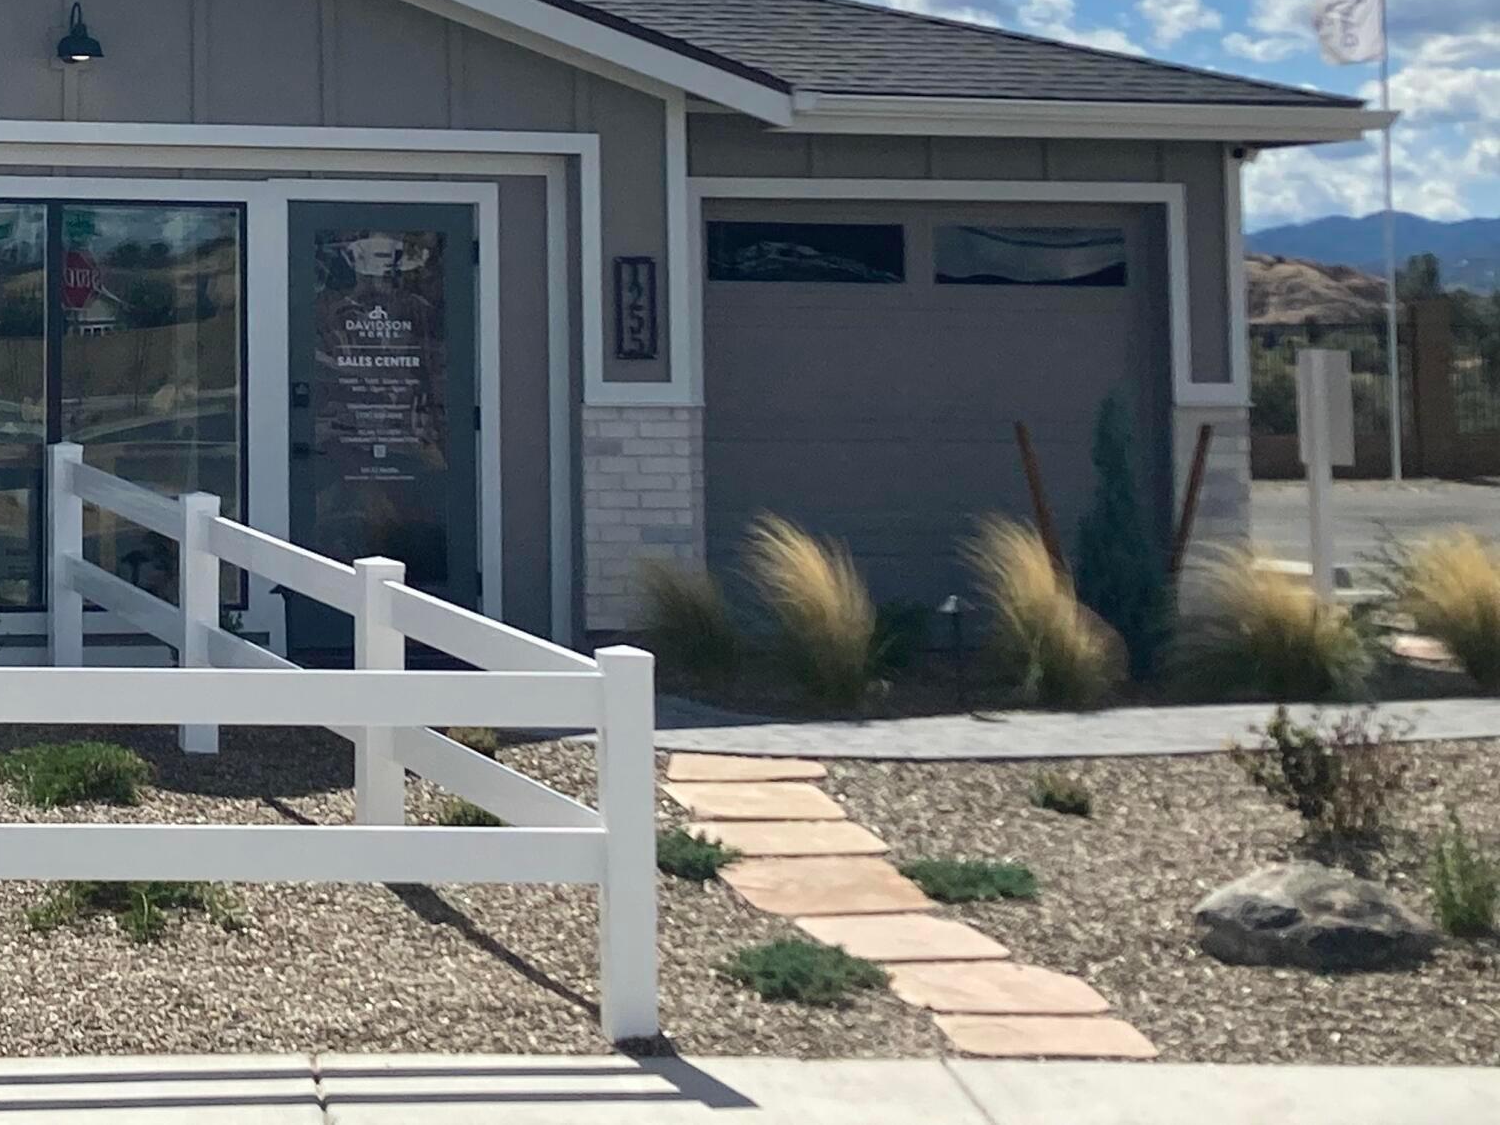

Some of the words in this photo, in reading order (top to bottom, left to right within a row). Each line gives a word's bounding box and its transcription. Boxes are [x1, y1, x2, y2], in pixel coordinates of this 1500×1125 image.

[345, 320, 412, 331] DAVIDSON
[337, 356, 373, 367] SALES
[374, 356, 420, 367] CENTER
